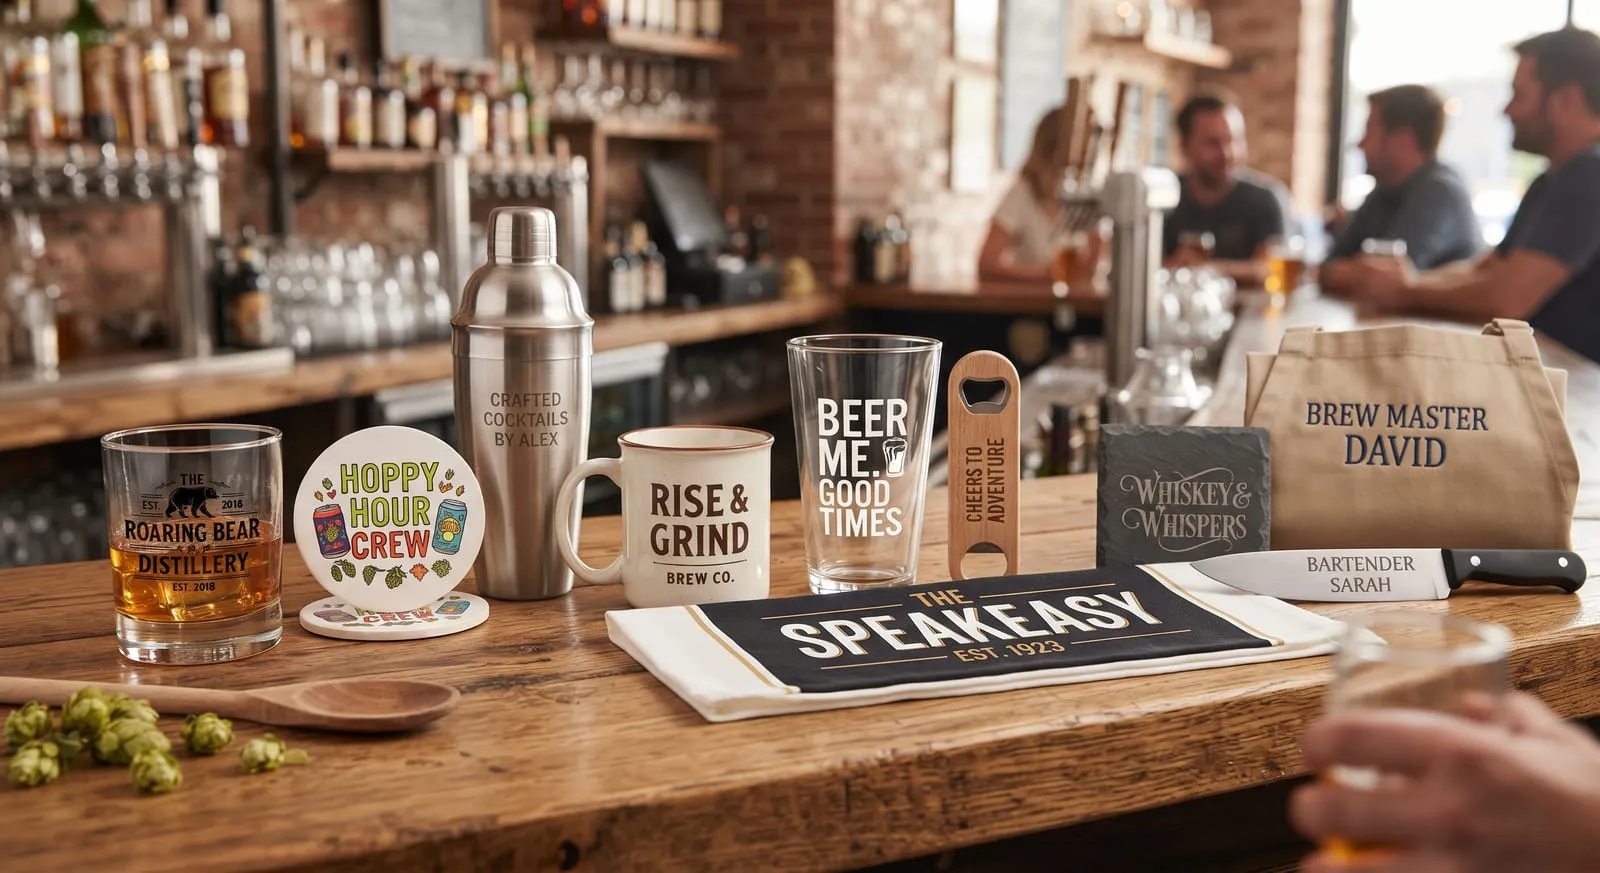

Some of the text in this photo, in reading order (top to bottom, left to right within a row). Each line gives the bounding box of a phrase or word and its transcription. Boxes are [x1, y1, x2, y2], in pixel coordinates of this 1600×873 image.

[490, 392, 561, 407] CRAFTED
[484, 410, 568, 427] COCKTAILS
[818, 398, 908, 438] BEER
[1306, 402, 1489, 431] BREW MASTER
[495, 431, 558, 447] BY ALEX
[1345, 434, 1447, 468] DAVID
[818, 438, 880, 478] ME.
[180, 473, 204, 485] THE
[340, 461, 439, 494] HOPPY
[966, 446, 983, 523] CHEERS TO
[987, 438, 1005, 523] ADVENTURE
[142, 500, 161, 511] EST.
[650, 482, 749, 518] RISE &
[819, 478, 891, 508] GOOD
[349, 495, 431, 529] HOUR
[819, 507, 903, 537] TIMES
[124, 518, 260, 543] ROARING BEAR
[351, 529, 431, 560] CREW
[650, 521, 749, 557] GRIND
[138, 552, 249, 575] DISTILLERY
[667, 571, 735, 585] BREW CO.
[1306, 556, 1416, 572] BARTENDER
[172, 582, 216, 592] EST. 2018
[909, 588, 974, 608] THE
[1330, 577, 1391, 593] SARAH
[780, 591, 1163, 659] SPEAKEASY
